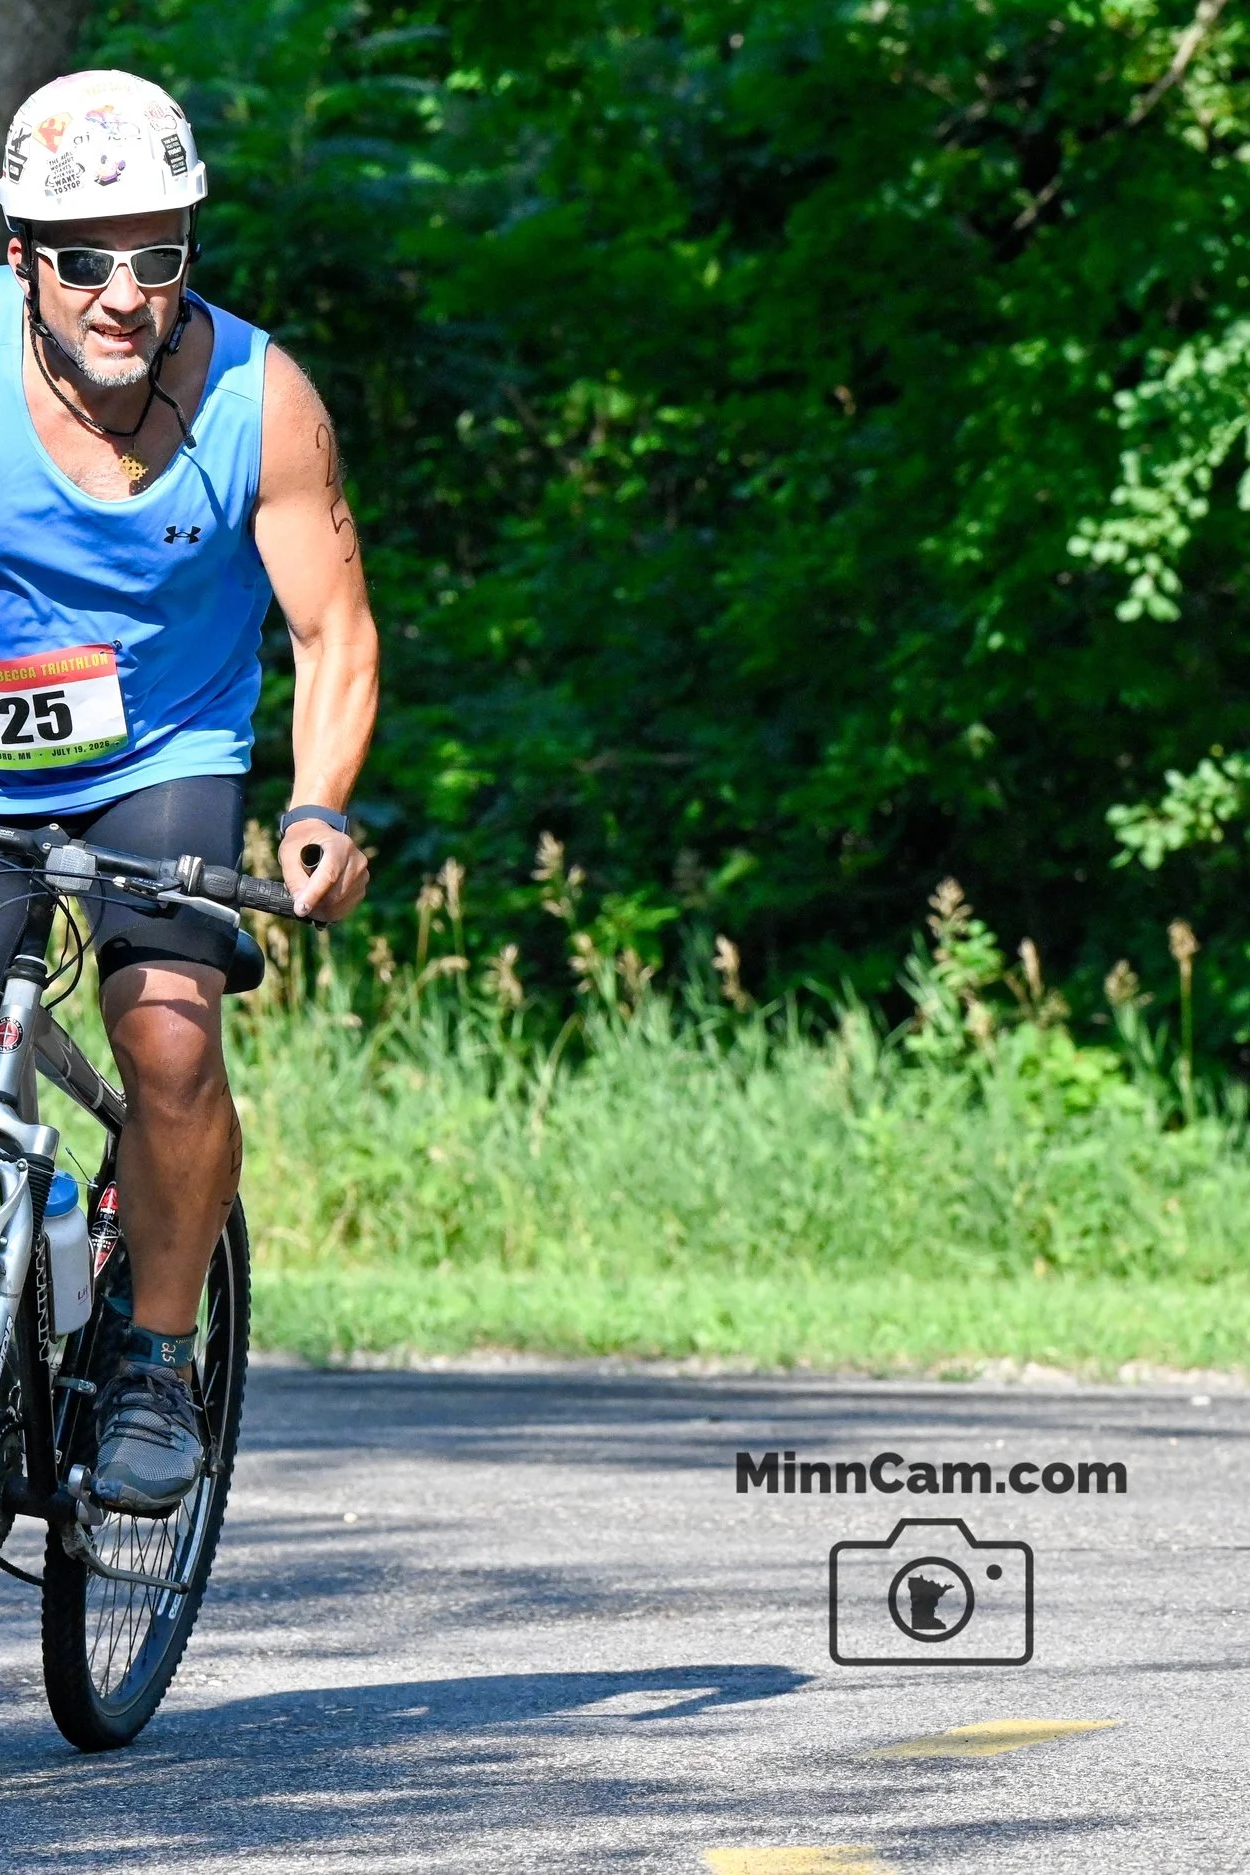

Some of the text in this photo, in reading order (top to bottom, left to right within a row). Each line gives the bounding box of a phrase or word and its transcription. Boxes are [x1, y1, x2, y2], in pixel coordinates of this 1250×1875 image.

[53, 180, 81, 195] TO STOP
[54, 174, 76, 187] WANT
[40, 652, 109, 677] TRIATHLON
[18, 752, 32, 761] MN
[51, 747, 71, 757] JULY
